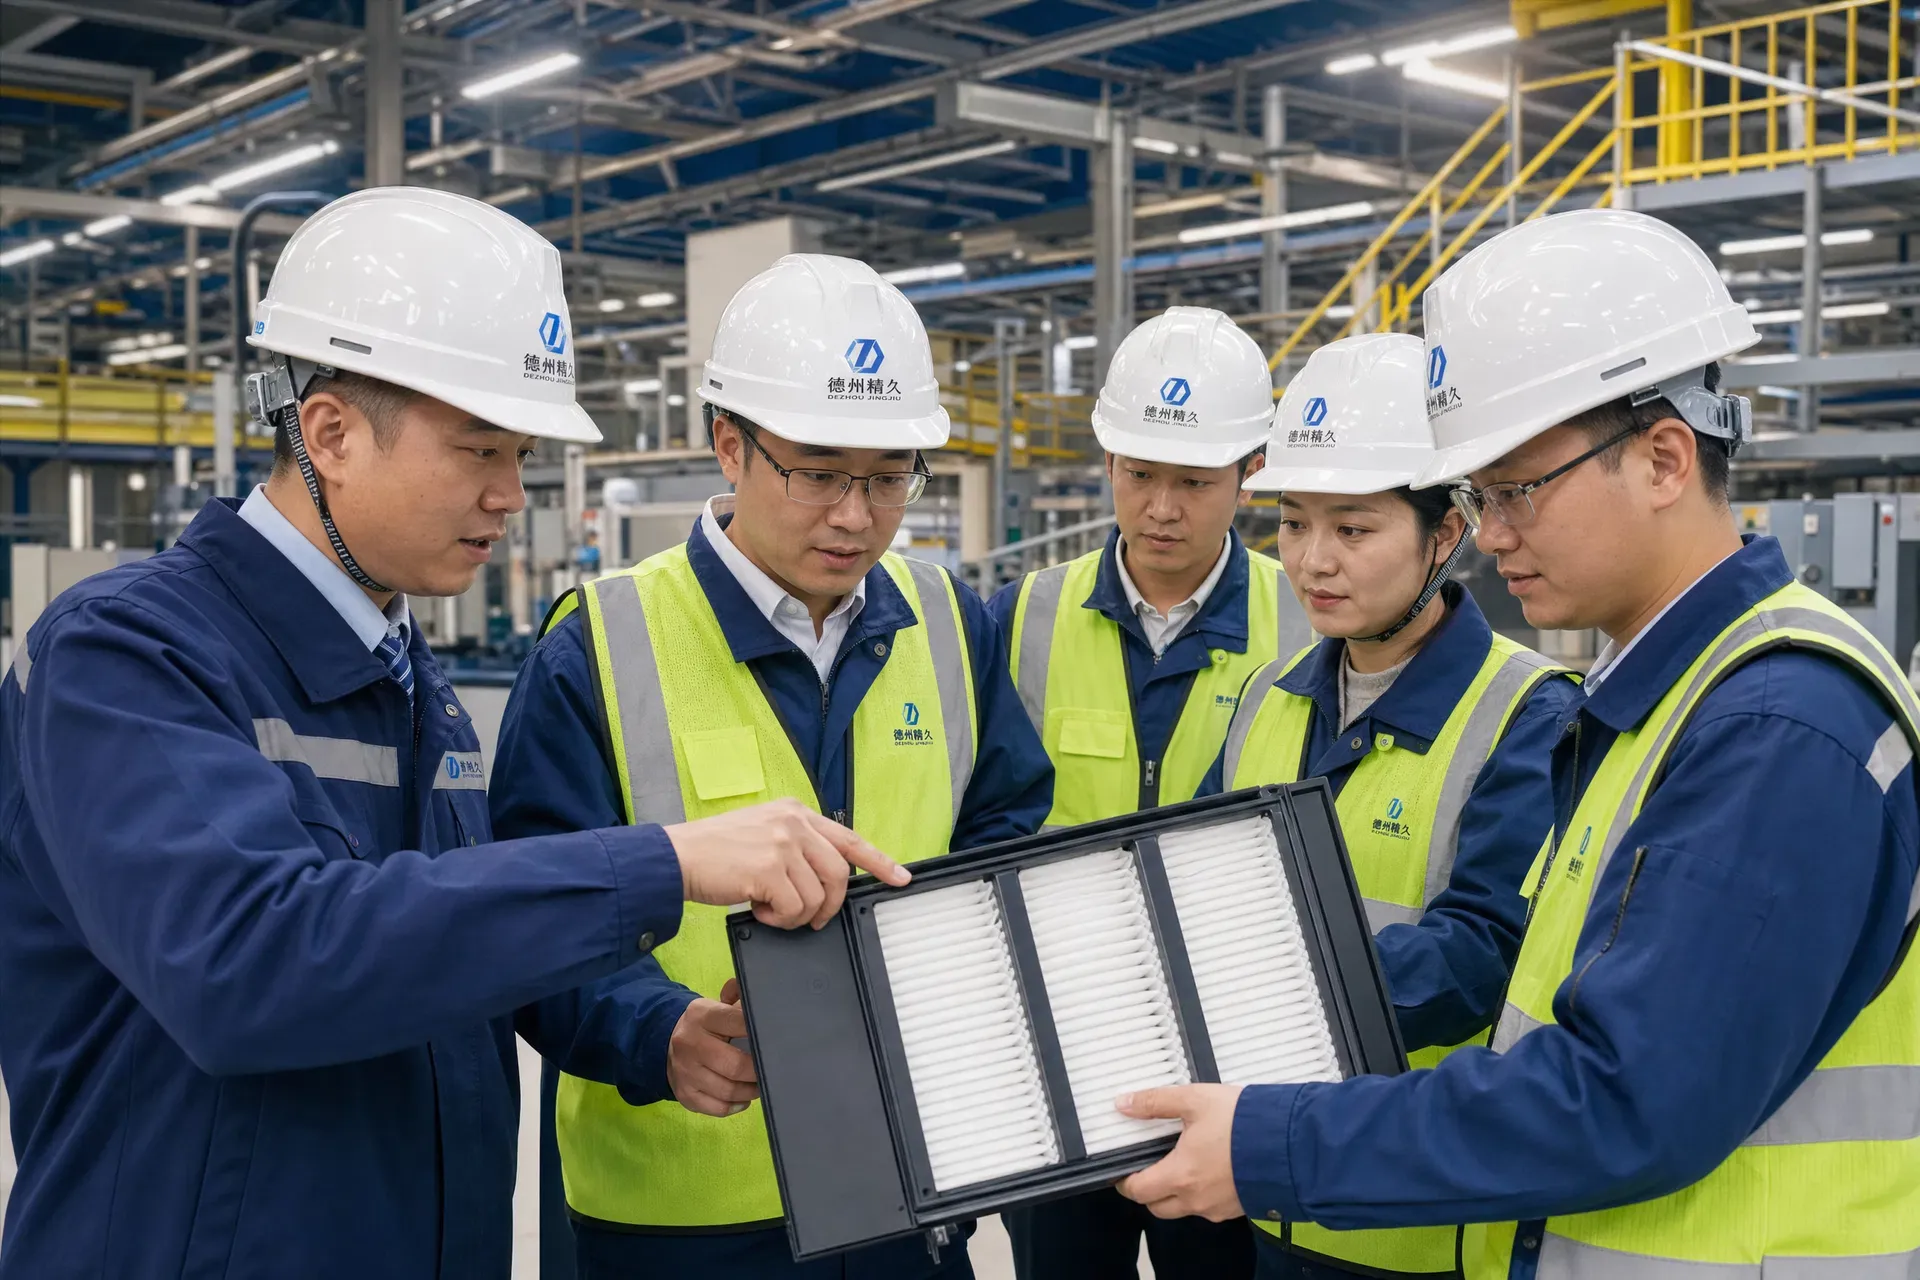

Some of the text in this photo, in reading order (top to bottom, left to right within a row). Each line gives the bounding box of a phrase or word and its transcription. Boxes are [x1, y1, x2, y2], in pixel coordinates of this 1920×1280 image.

[523, 353, 575, 379] 德州精久
[523, 372, 555, 382] DEZHOU
[827, 377, 902, 394] 德州精久
[1144, 405, 1199, 424] 德州精久
[1288, 429, 1336, 443] 德州精久
